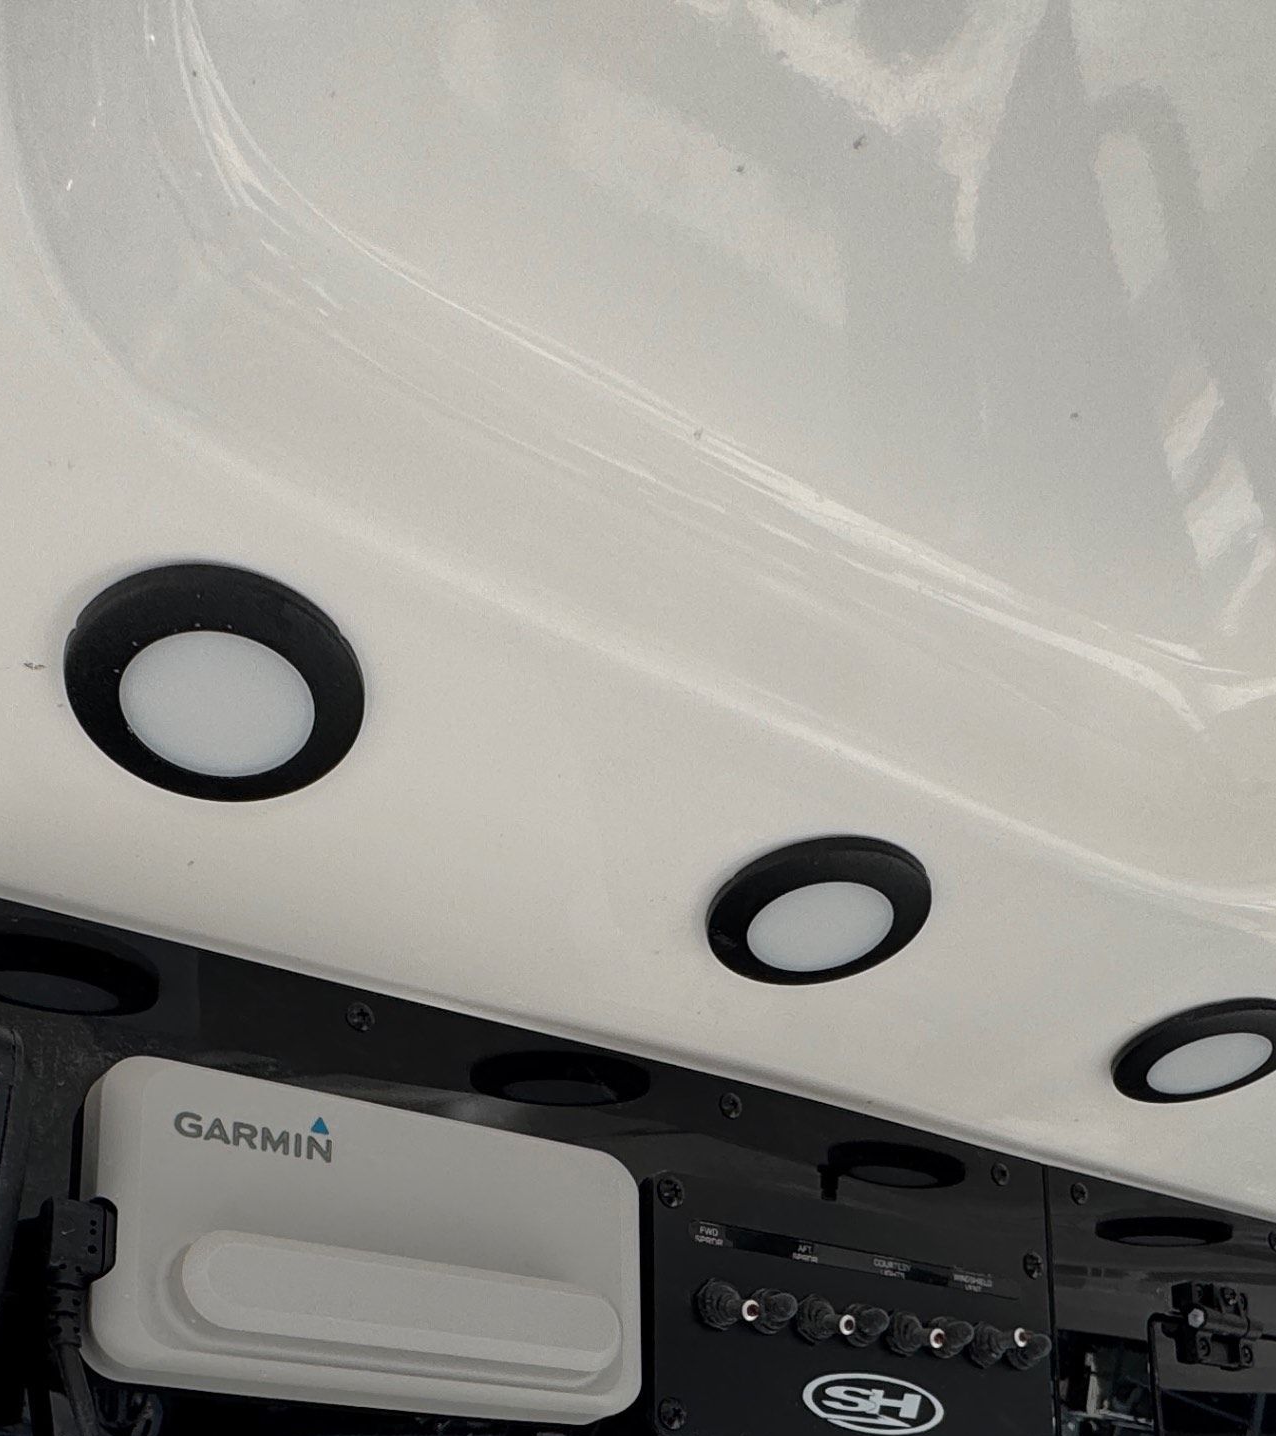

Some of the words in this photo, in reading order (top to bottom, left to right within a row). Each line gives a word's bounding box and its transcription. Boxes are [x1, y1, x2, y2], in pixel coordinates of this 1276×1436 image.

[174, 1112, 332, 1163] GARMIN
[698, 1225, 720, 1238] FWD
[796, 1243, 814, 1255] AFT
[821, 1385, 922, 1420] SH
